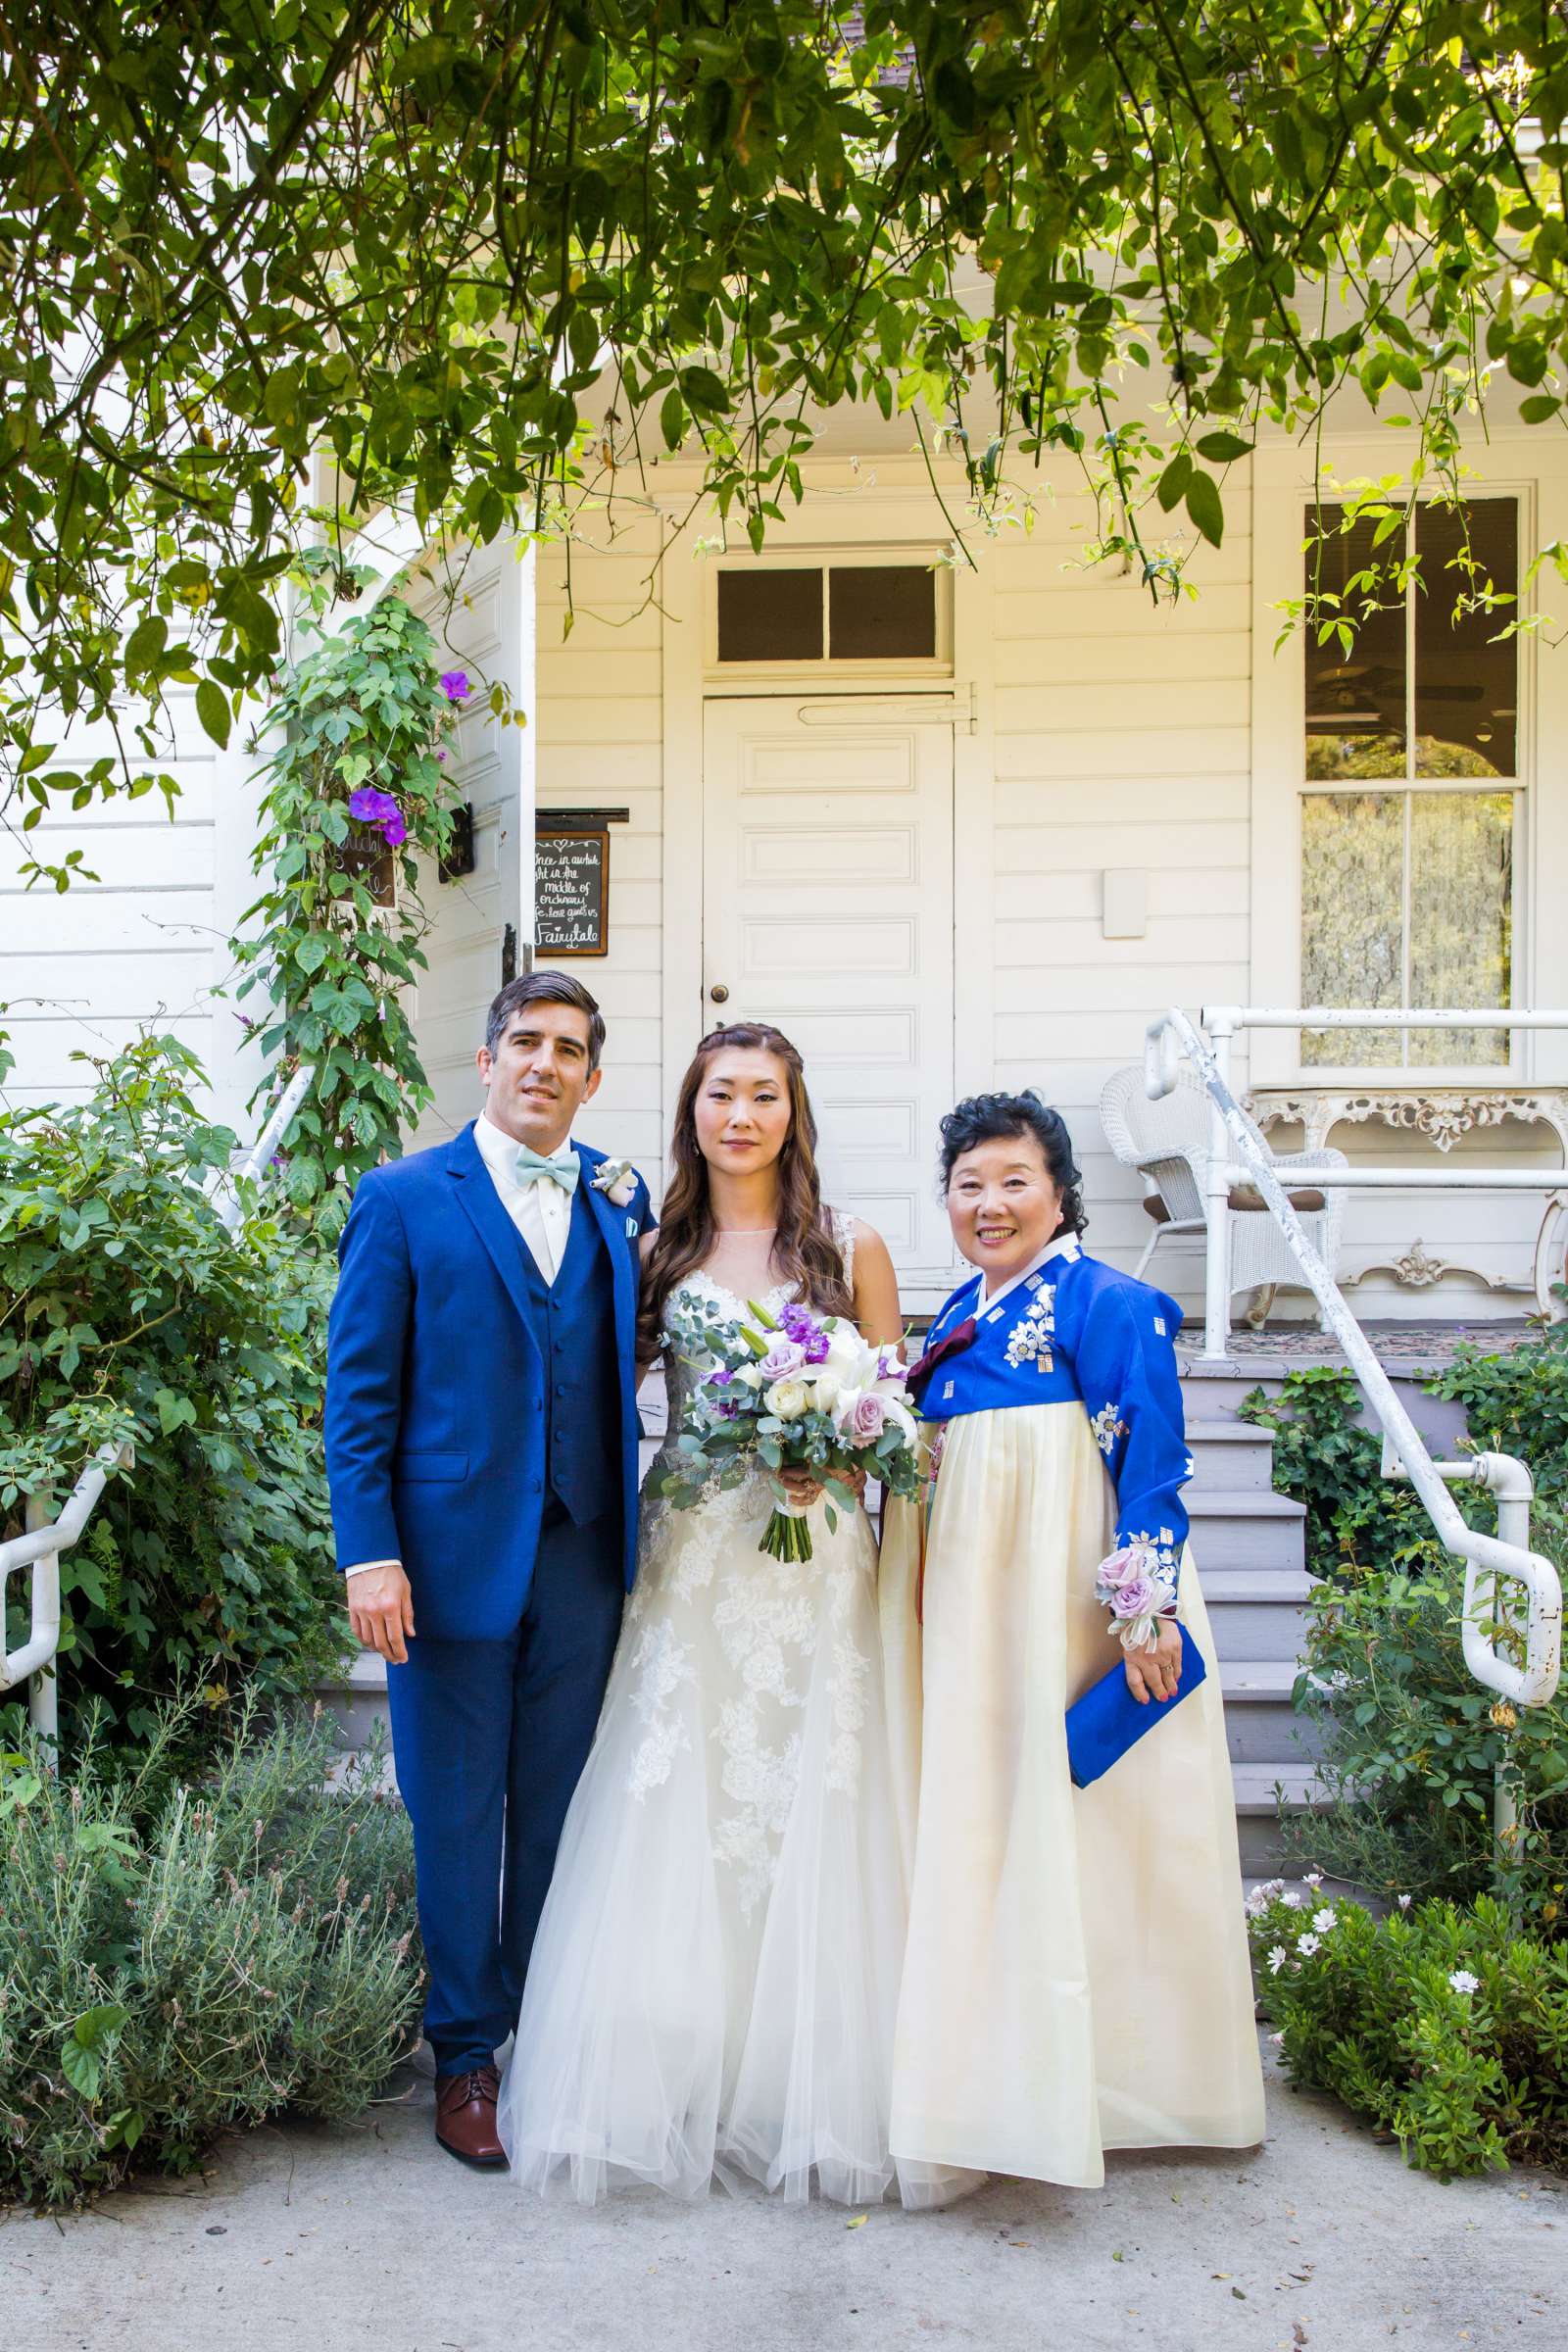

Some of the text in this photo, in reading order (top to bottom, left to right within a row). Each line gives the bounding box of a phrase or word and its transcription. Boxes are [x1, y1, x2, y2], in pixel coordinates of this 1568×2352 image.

[558, 854, 570, 865] in
[571, 852, 601, 865] awhile
[550, 868, 563, 879] in
[563, 865, 579, 880] the
[545, 881, 591, 897] middle of
[540, 893, 585, 907] ordinary
[548, 906, 565, 918] love
[534, 922, 598, 950] Fairytale
